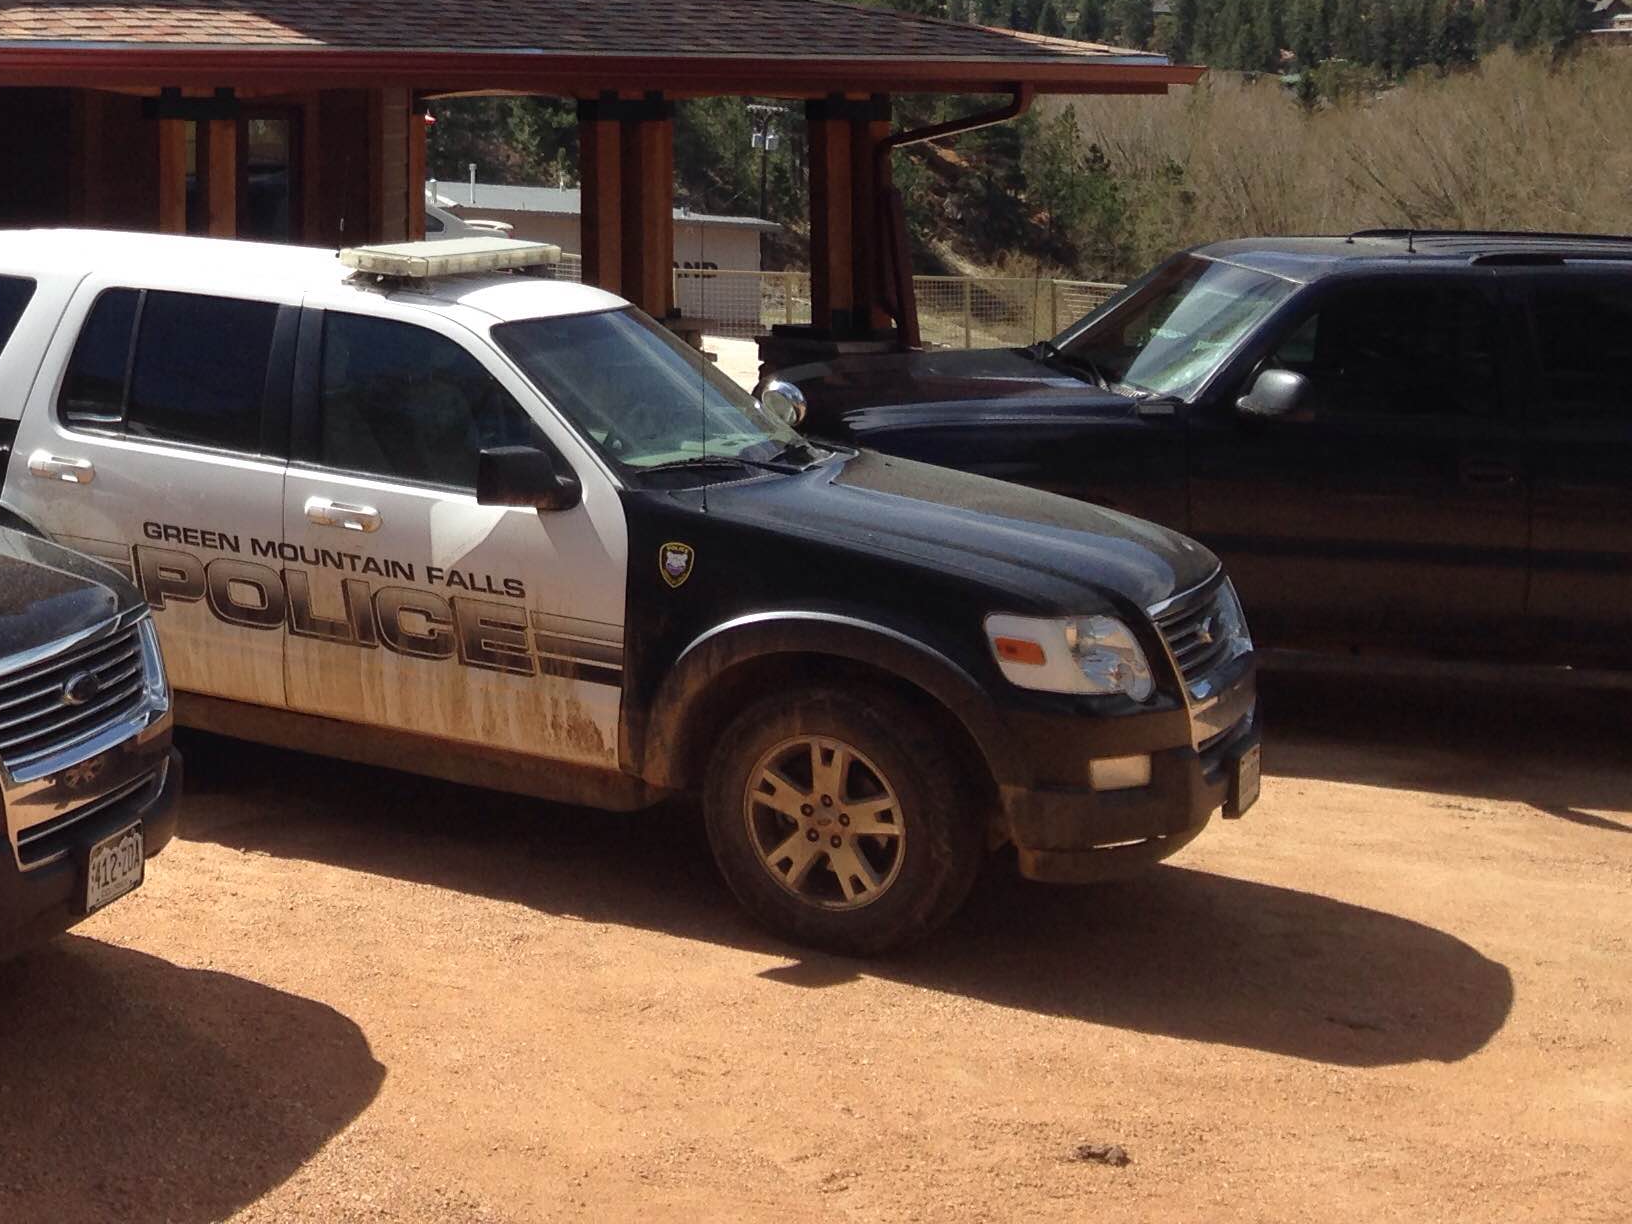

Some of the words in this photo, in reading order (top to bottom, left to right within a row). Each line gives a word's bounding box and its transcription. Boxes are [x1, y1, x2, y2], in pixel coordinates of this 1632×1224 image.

[132, 543, 536, 677] POLICE
[143, 521, 240, 553] GREEN
[251, 538, 415, 582] MOUNTAIN
[426, 565, 526, 599] FALLS
